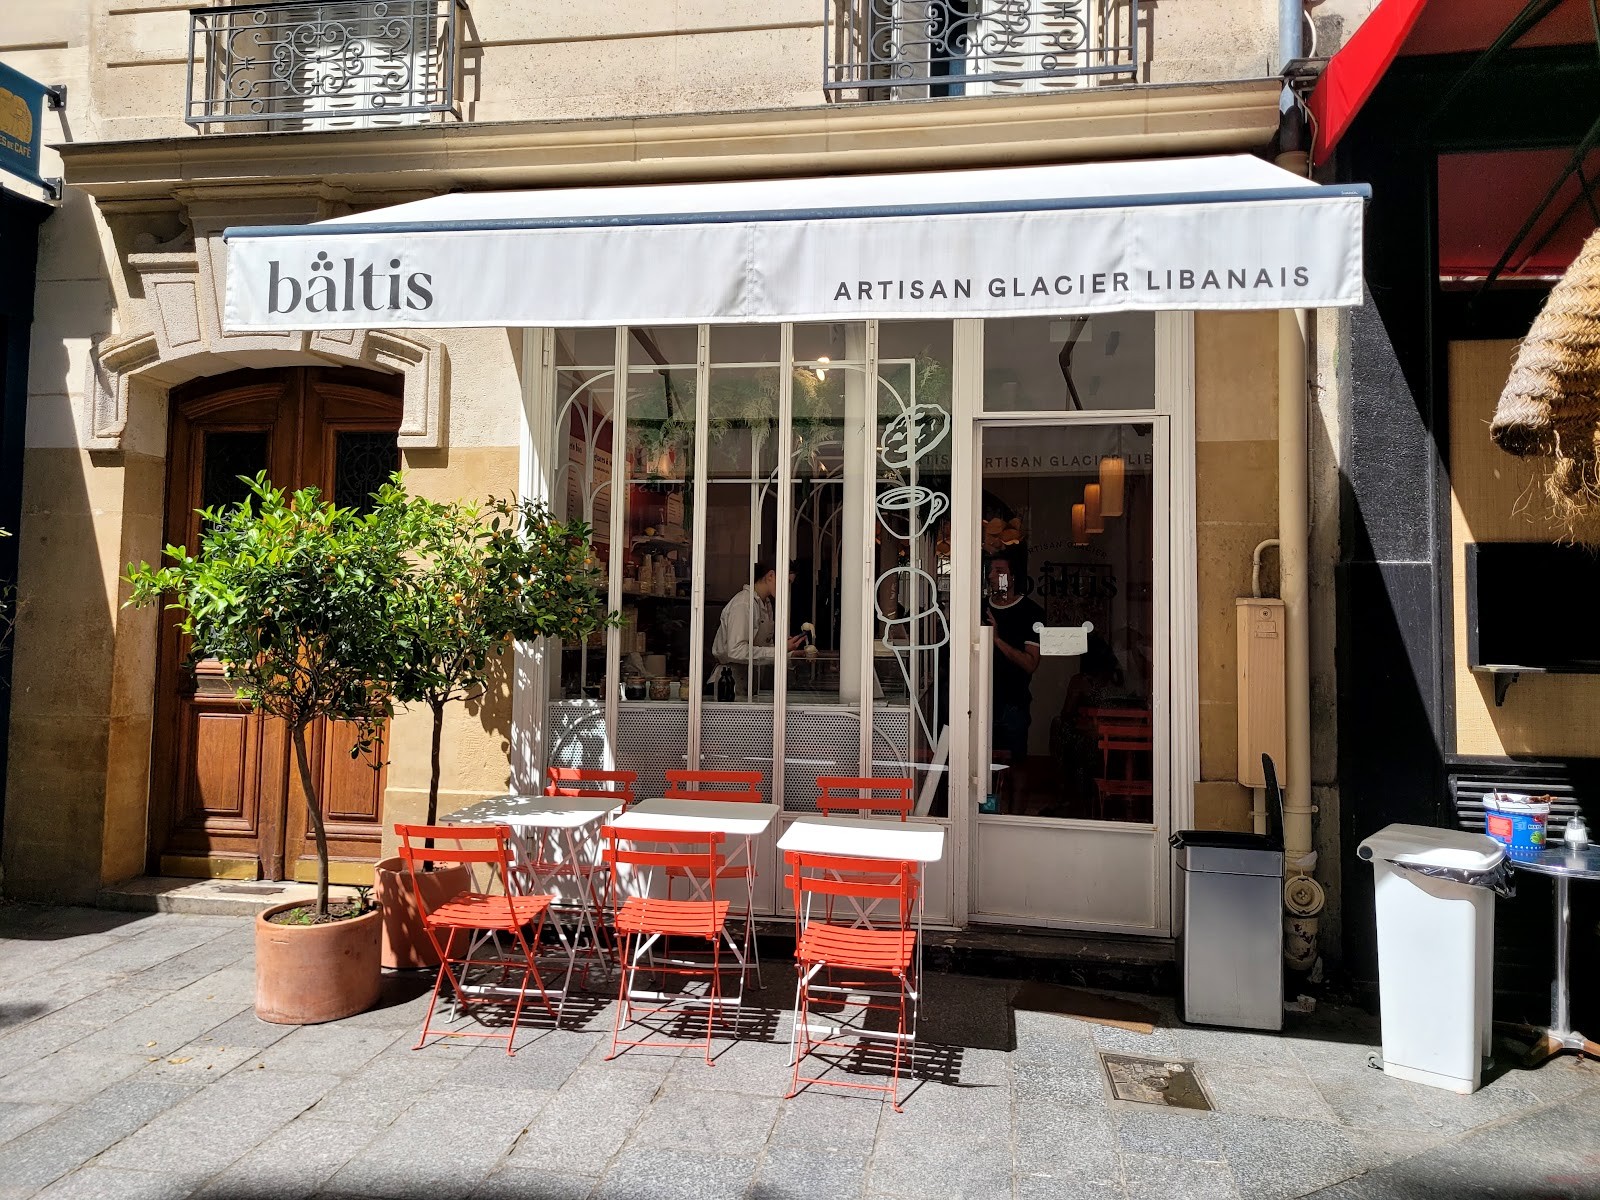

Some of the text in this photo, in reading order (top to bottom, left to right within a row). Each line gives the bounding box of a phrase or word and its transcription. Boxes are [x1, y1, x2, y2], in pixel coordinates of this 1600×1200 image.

[15, 142, 31, 158] CAFÉ
[833, 266, 1309, 300] ARTISAN GLACIER LIBANAIS
